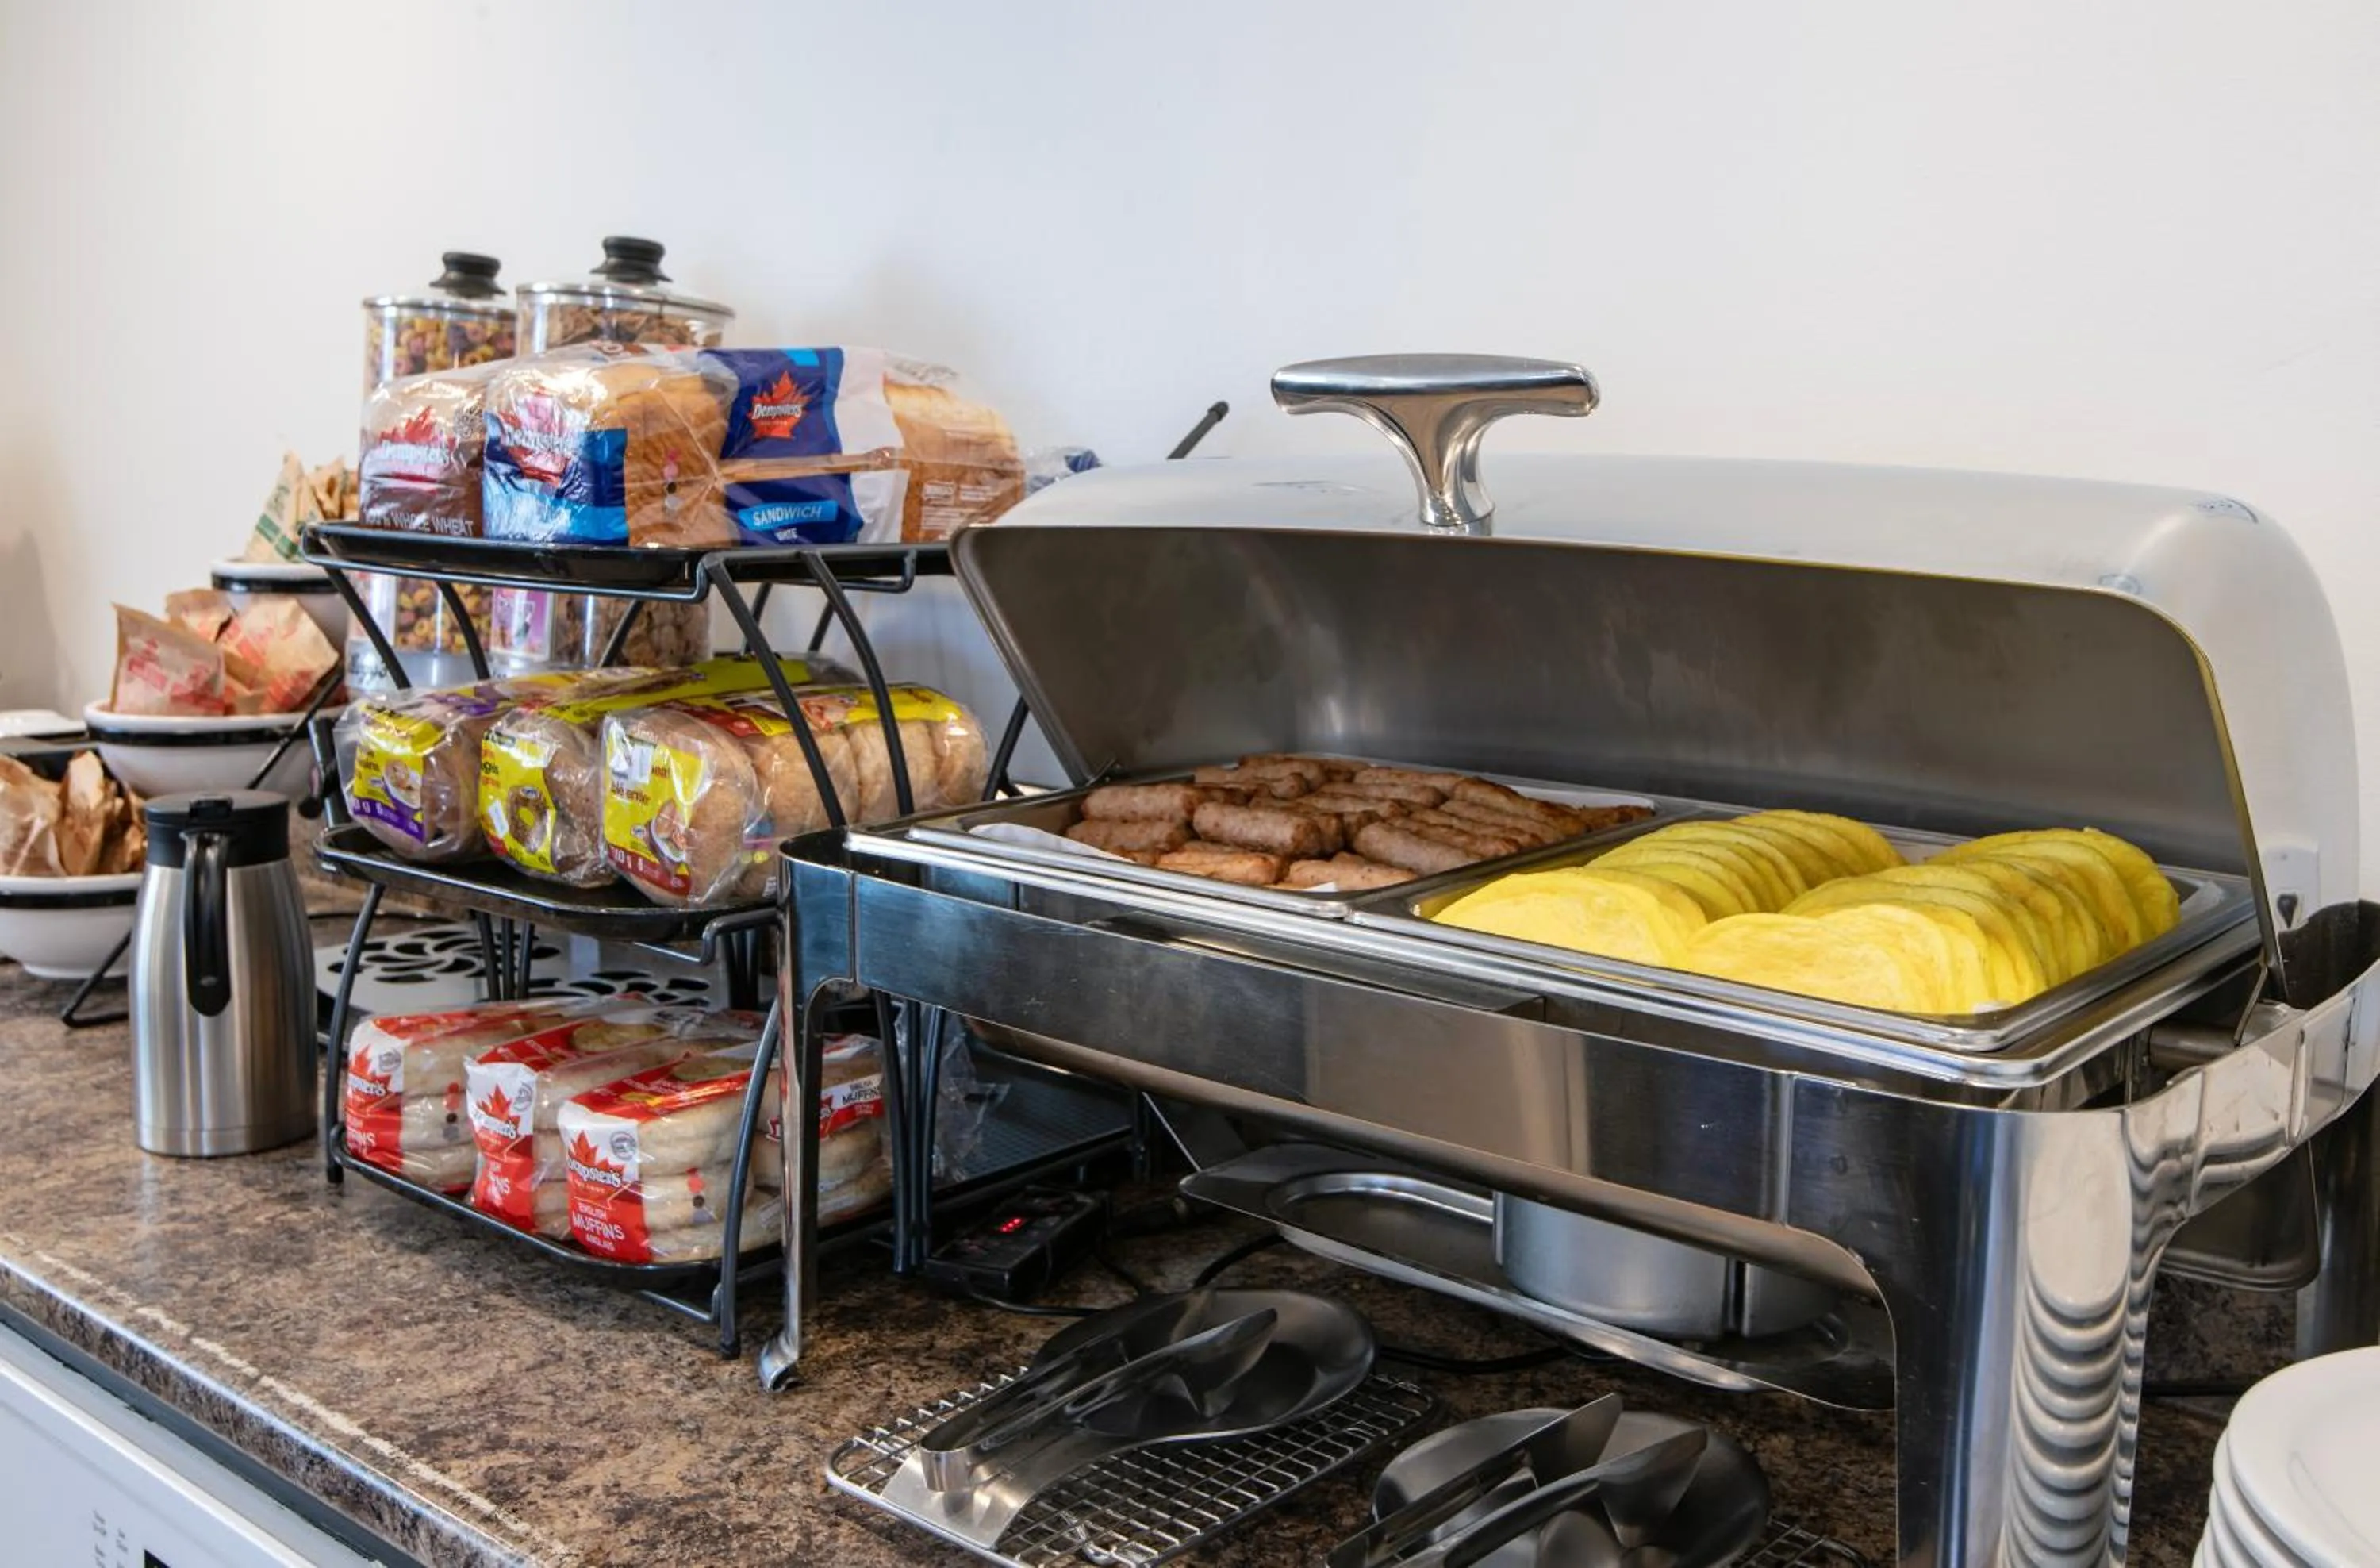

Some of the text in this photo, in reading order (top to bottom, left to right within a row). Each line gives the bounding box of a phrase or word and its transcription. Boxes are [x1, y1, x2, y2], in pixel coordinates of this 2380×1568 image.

[432, 513, 474, 537] WHEAT
[752, 505, 823, 527] SANDWICH
[842, 1086, 884, 1104] MUFFIN
[572, 1211, 625, 1241] MUFFINS
